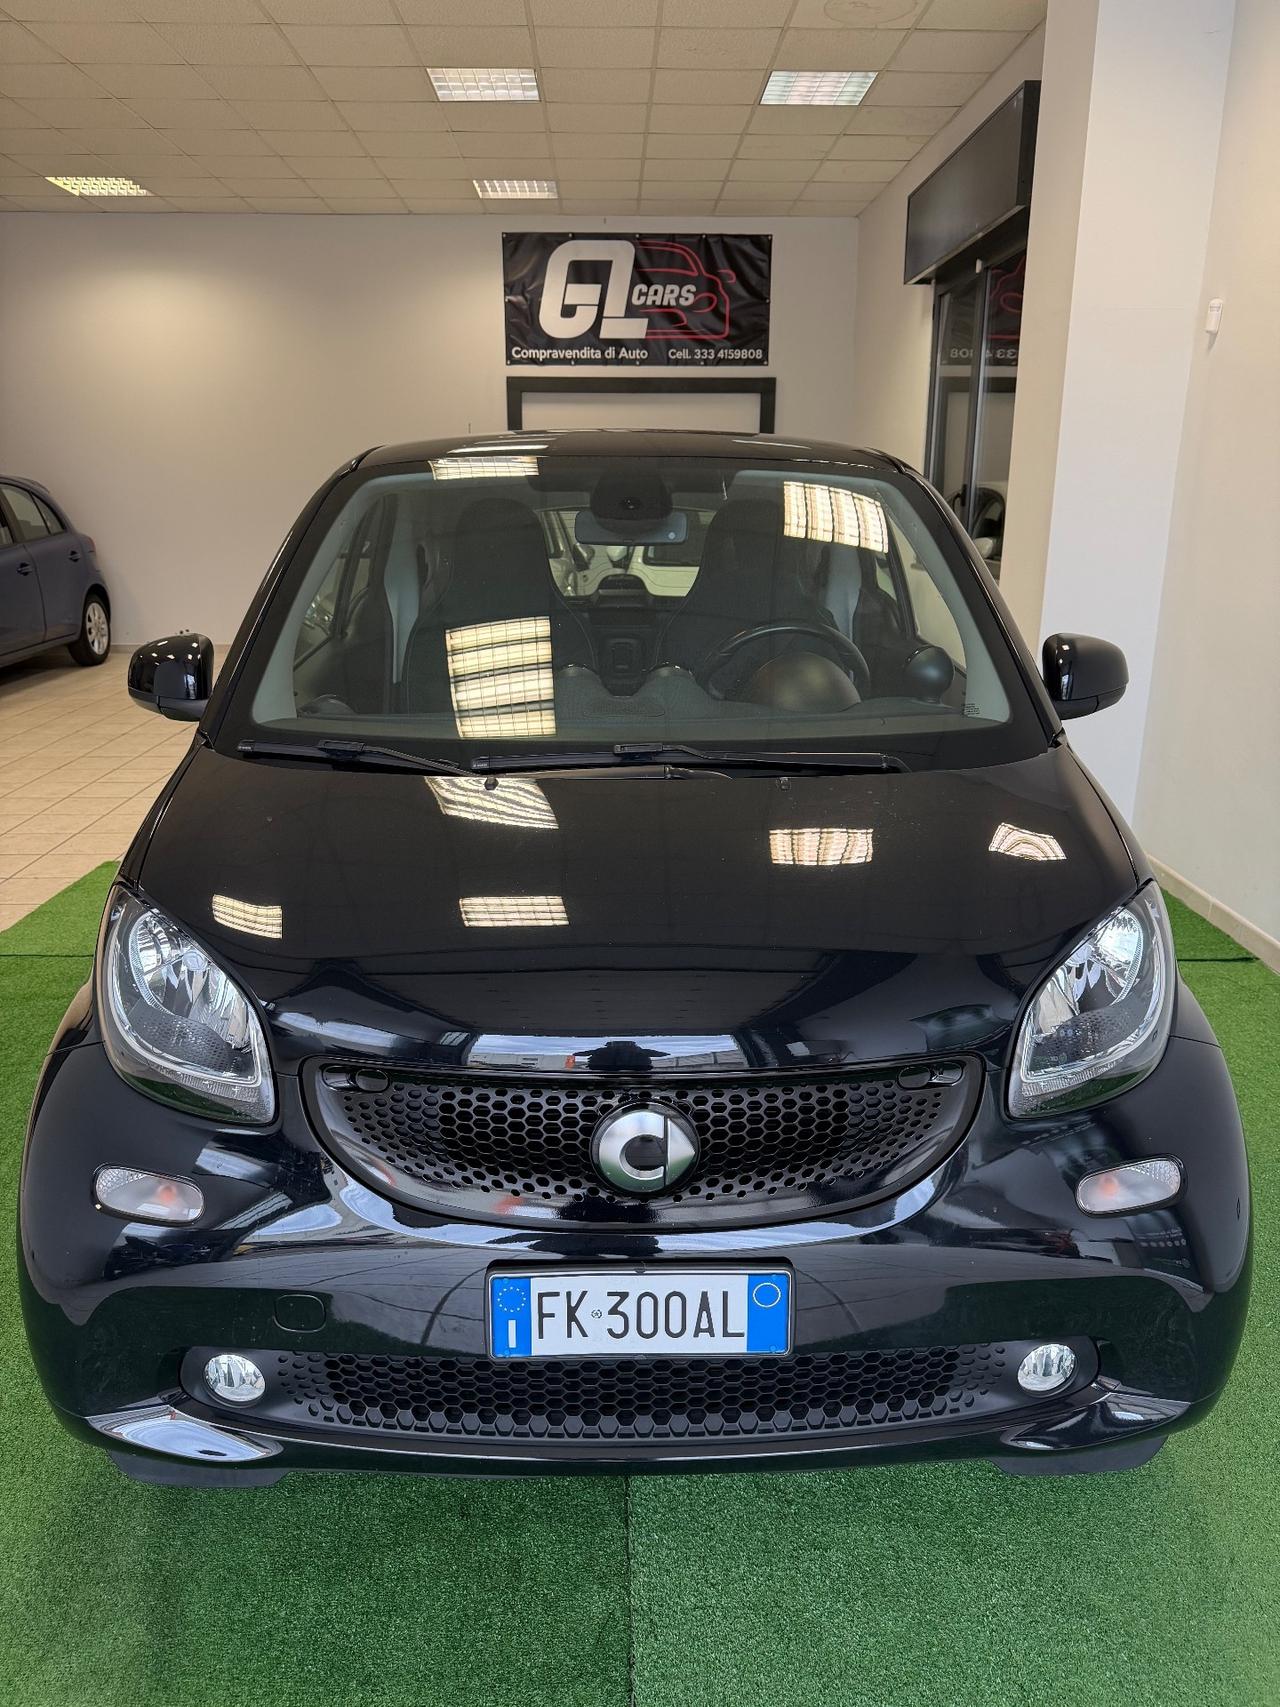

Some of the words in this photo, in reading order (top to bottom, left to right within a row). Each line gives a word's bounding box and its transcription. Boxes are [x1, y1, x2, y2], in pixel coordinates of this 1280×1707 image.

[631, 284, 698, 307] CARS
[511, 347, 601, 360] Compravendita
[604, 347, 616, 359] di
[618, 348, 649, 359] Auto
[668, 349, 692, 359] Cell.
[694, 349, 715, 359] 333
[717, 349, 763, 360] 4159808
